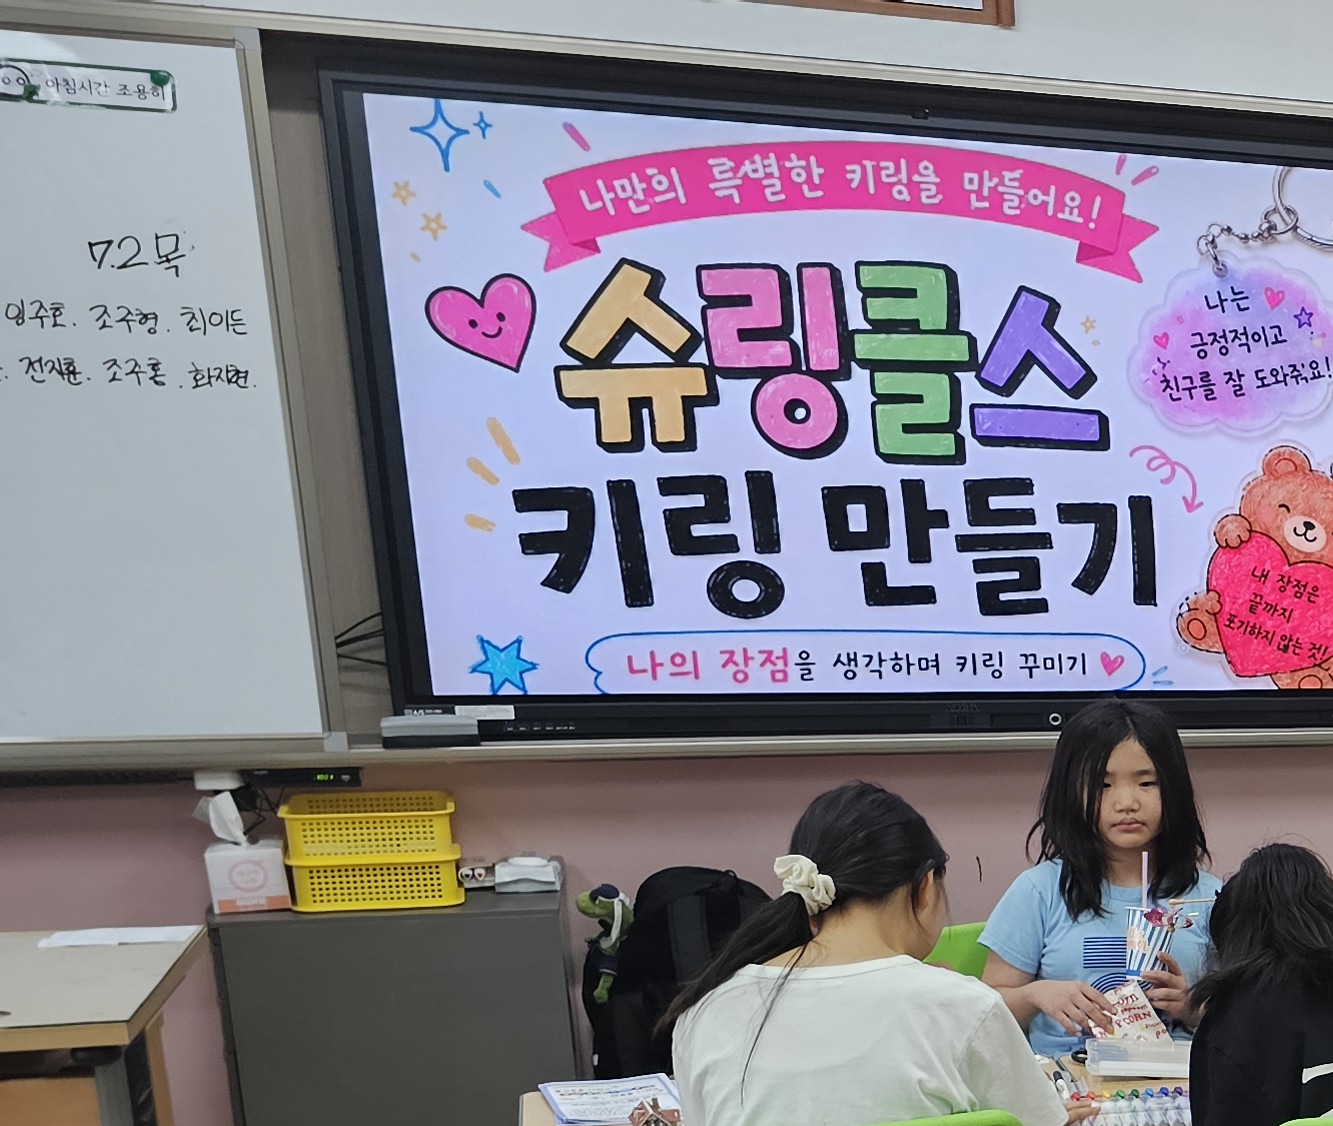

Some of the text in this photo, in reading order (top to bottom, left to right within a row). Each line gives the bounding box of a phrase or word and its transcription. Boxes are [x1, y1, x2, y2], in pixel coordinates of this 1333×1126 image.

[46, 77, 165, 101] 아침시간 조용히
[846, 157, 942, 205] 키링을
[962, 169, 1101, 231] 만들어요!
[1205, 286, 1249, 313] 나는
[1190, 325, 1287, 359] 긍정적이고
[555, 258, 1110, 464] 슈링클스
[1160, 370, 1217, 401] 친구를
[1225, 368, 1246, 397] 잘
[512, 470, 1157, 619] 키링 만들기
[1251, 566, 1320, 604] 내 장점은
[1249, 591, 1294, 623] 끝까지
[1224, 614, 1276, 646] 포기하지
[1308, 642, 1329, 661] 것!
[626, 647, 1088, 683] 나의 장점을 생각하며 키링 꾸미기
